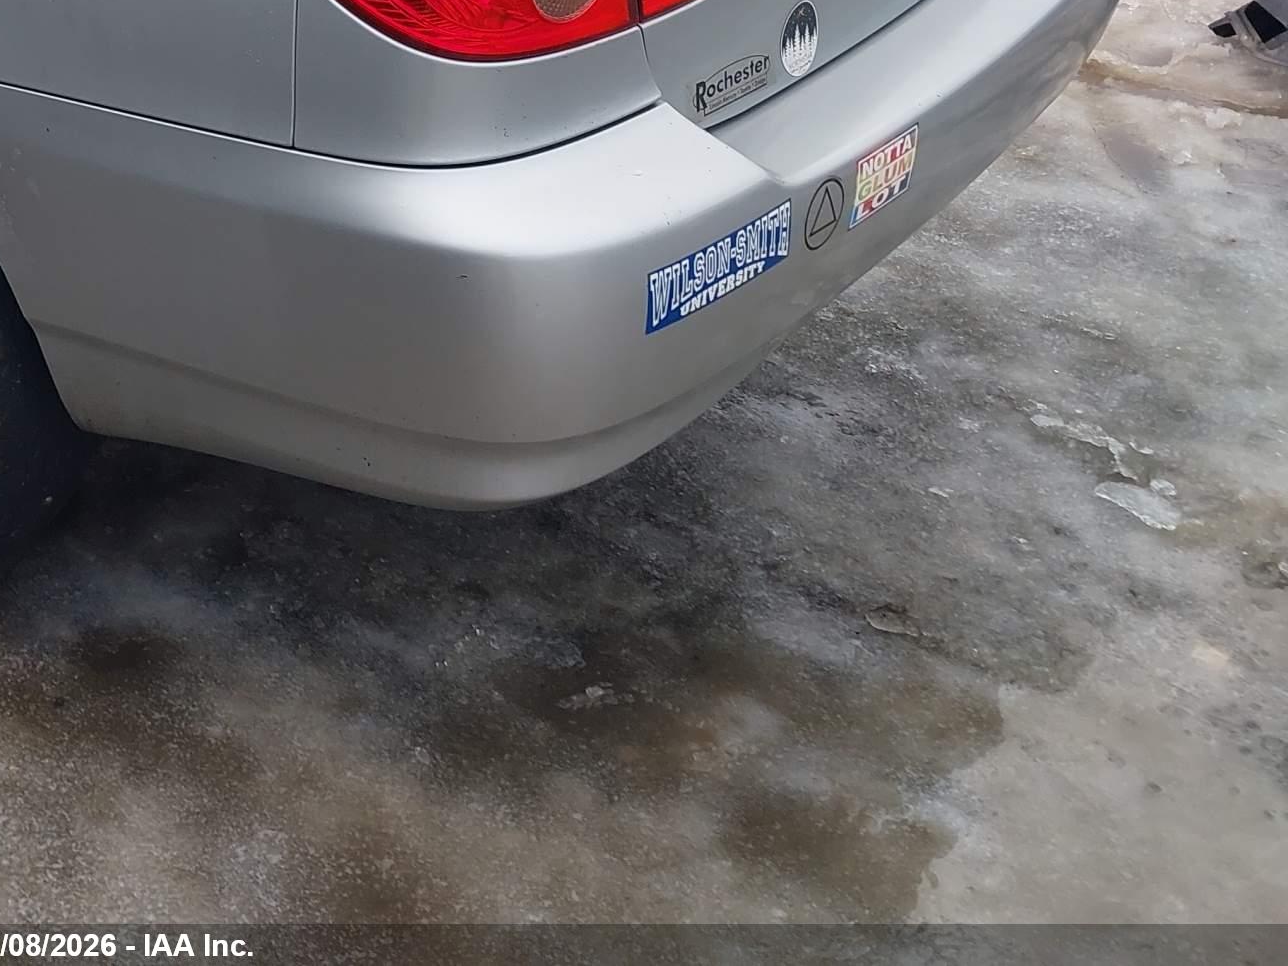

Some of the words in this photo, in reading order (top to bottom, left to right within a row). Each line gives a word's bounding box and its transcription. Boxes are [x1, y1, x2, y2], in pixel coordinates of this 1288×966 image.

[695, 56, 770, 112] Rochester
[858, 153, 912, 201] GLUM
[861, 133, 912, 180] NOTTA
[855, 175, 906, 221] LOT
[650, 201, 791, 327] WILSON-SMITH
[680, 260, 766, 316] UNIVERSITY
